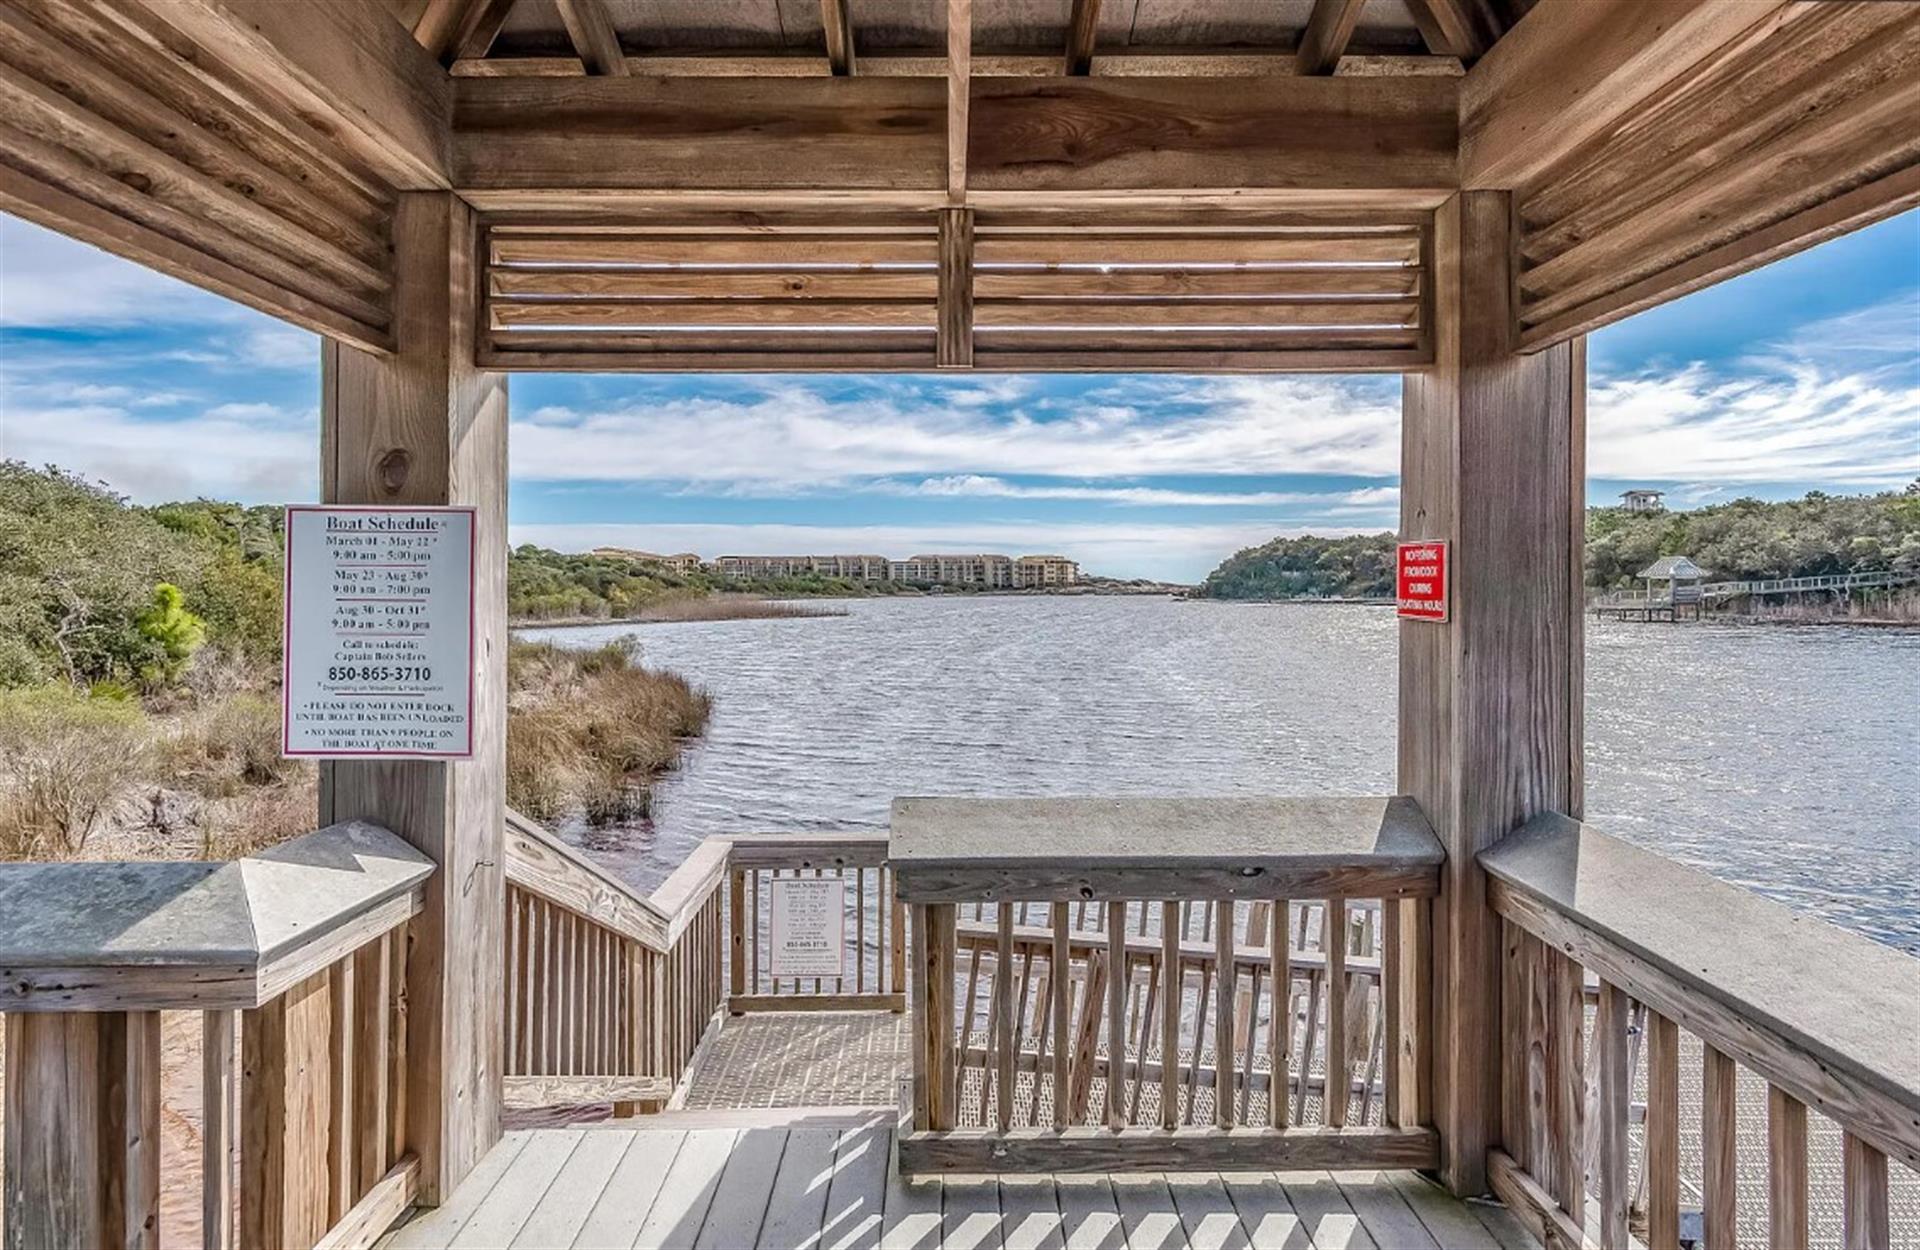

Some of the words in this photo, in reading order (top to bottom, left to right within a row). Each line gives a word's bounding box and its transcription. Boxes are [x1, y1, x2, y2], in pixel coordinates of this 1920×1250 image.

[326, 516, 362, 530] Boat
[368, 516, 439, 531] Schedule
[326, 536, 363, 547] March
[389, 537, 414, 549] May
[360, 553, 377, 561] am
[387, 551, 411, 561] 5:00
[413, 553, 431, 563] pm
[334, 571, 358, 582] May
[362, 571, 375, 581] 23
[385, 572, 407, 583] Aug
[333, 585, 357, 594] 9:00
[387, 585, 411, 595] 7:00
[413, 587, 431, 597] pm
[336, 606, 359, 617] Aug
[385, 606, 405, 615] Oct
[332, 620, 356, 629] 9:00
[386, 620, 411, 629] 5:00
[412, 622, 431, 631] pm
[342, 640, 363, 649] Call
[365, 641, 373, 649] to
[334, 653, 374, 662] Captain
[375, 653, 393, 661] Bob
[328, 667, 432, 681] 850-865-3710
[309, 702, 346, 711] PLEASE
[351, 702, 365, 711] DO
[367, 702, 388, 711] NOT
[390, 702, 424, 712] ENTER
[295, 713, 325, 722] UNTIL
[328, 713, 354, 722] BOAT
[357, 713, 379, 722] HAS
[380, 713, 406, 722] BEEN
[408, 714, 464, 724] UNLOADED
[311, 728, 326, 737] NO
[329, 728, 357, 737] MORE
[360, 728, 389, 738] THAN
[398, 729, 437, 739] PEOPLE
[439, 729, 454, 739] ON
[322, 740, 340, 748] THE
[344, 740, 371, 749] BOAT
[373, 741, 386, 749] AT
[388, 741, 409, 749] ONE
[411, 741, 437, 750] TIME
